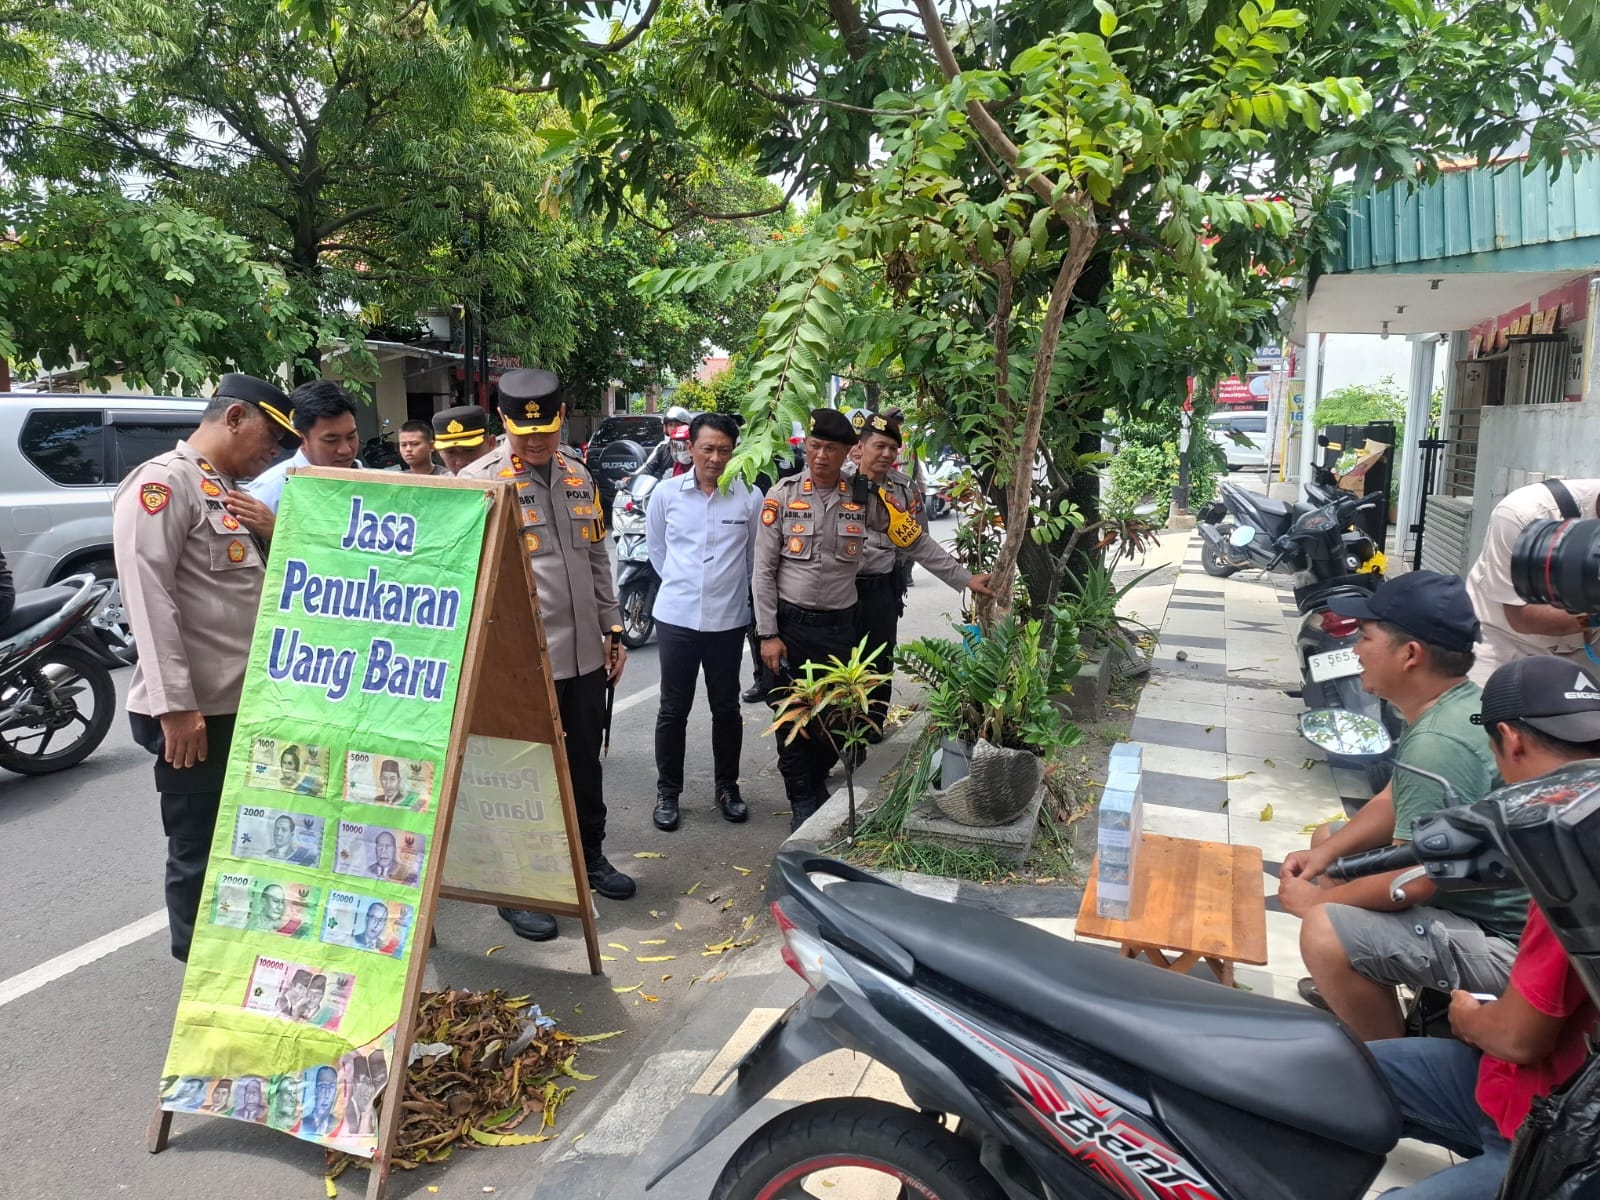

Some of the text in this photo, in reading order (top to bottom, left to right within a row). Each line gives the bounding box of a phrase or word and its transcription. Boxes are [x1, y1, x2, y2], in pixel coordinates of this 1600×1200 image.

[566, 490, 591, 500] POLRI
[838, 512, 864, 521] POLRI
[341, 496, 417, 555] Jasa
[278, 558, 460, 630] Penukaran
[267, 626, 449, 703] Uang Baru
[1313, 658, 1320, 667] S
[258, 739, 275, 748] 1000
[351, 753, 369, 762] 5000
[243, 807, 265, 818] 2000
[342, 823, 363, 834] 10000
[222, 874, 249, 886] 20000
[331, 892, 354, 904] 50000
[259, 957, 284, 970] 100000
